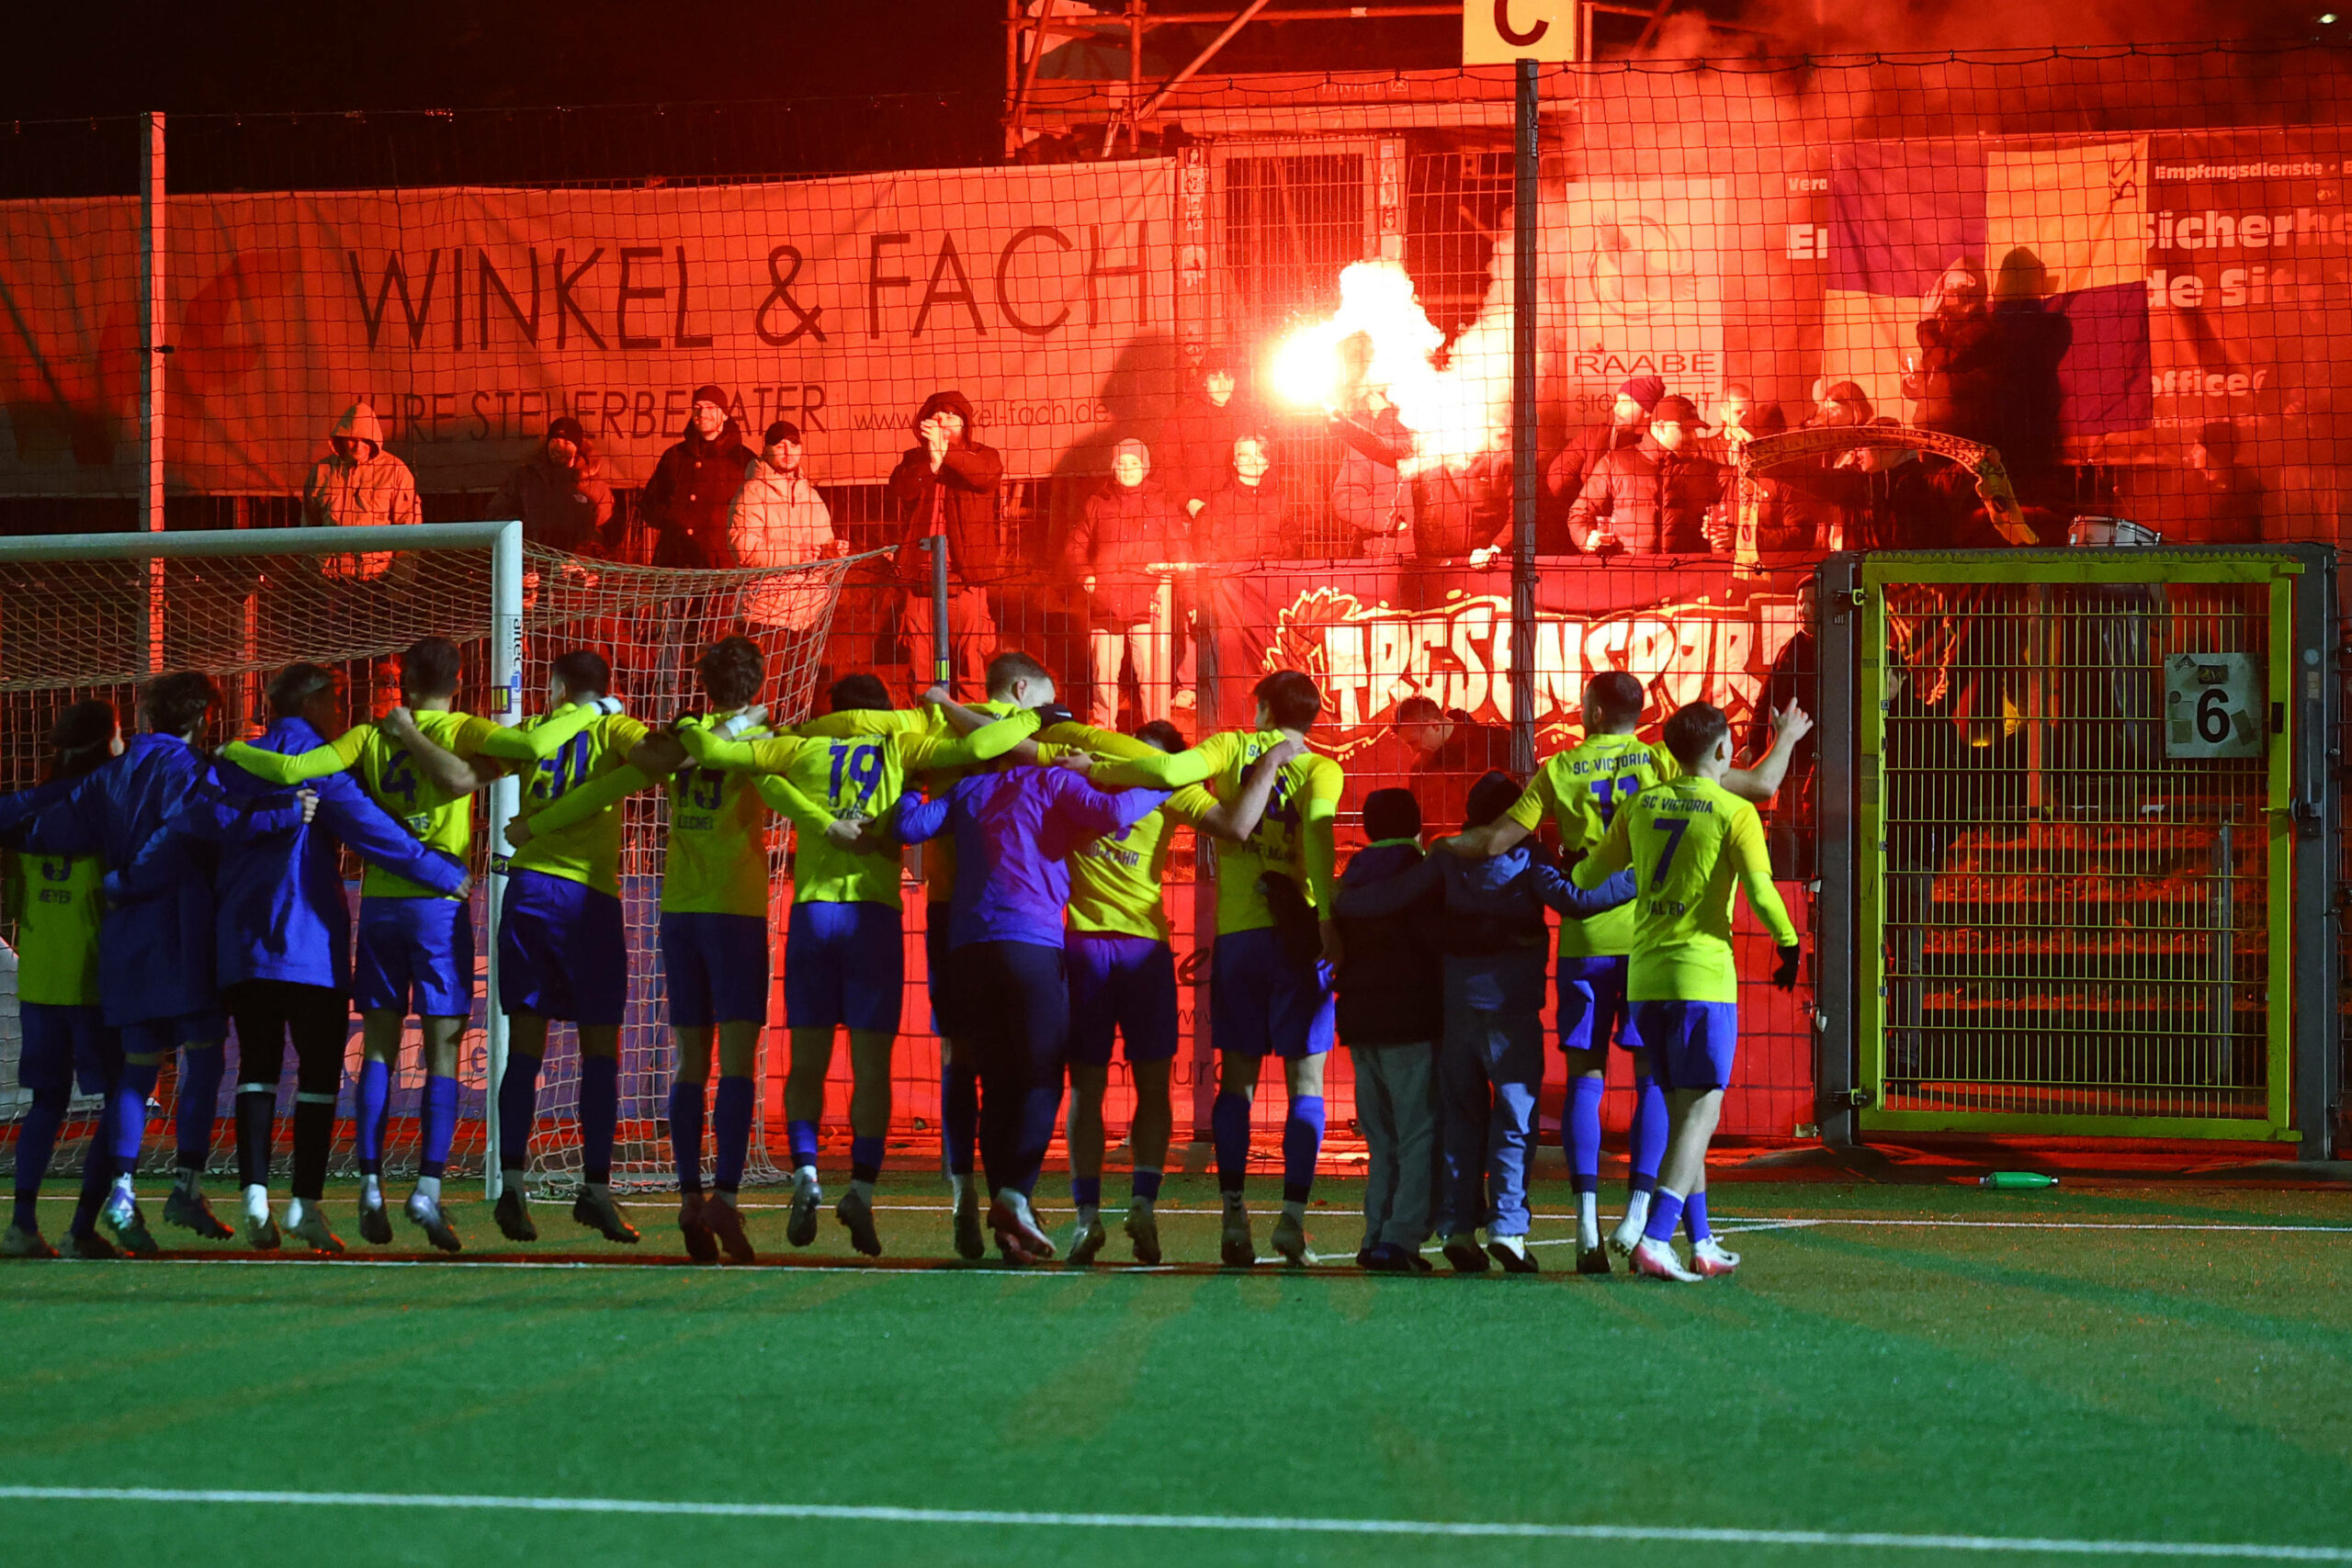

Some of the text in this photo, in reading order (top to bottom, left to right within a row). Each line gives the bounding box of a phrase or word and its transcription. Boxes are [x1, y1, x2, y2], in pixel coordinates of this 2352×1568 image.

[1494, 0, 1549, 47] C
[2154, 163, 2324, 181] Empfangsdienste
[348, 220, 1148, 353] WINKEL & FACH
[1574, 354, 1715, 375] RAABE
[357, 393, 456, 442] HRE
[469, 385, 827, 441] STEUERBEATER
[2197, 688, 2231, 743] 6
[829, 745, 885, 808] 19
[1573, 752, 1652, 774] SC VICTORIA
[1643, 795, 1713, 814] SC VICTORIA
[1654, 818, 1690, 892] 7
